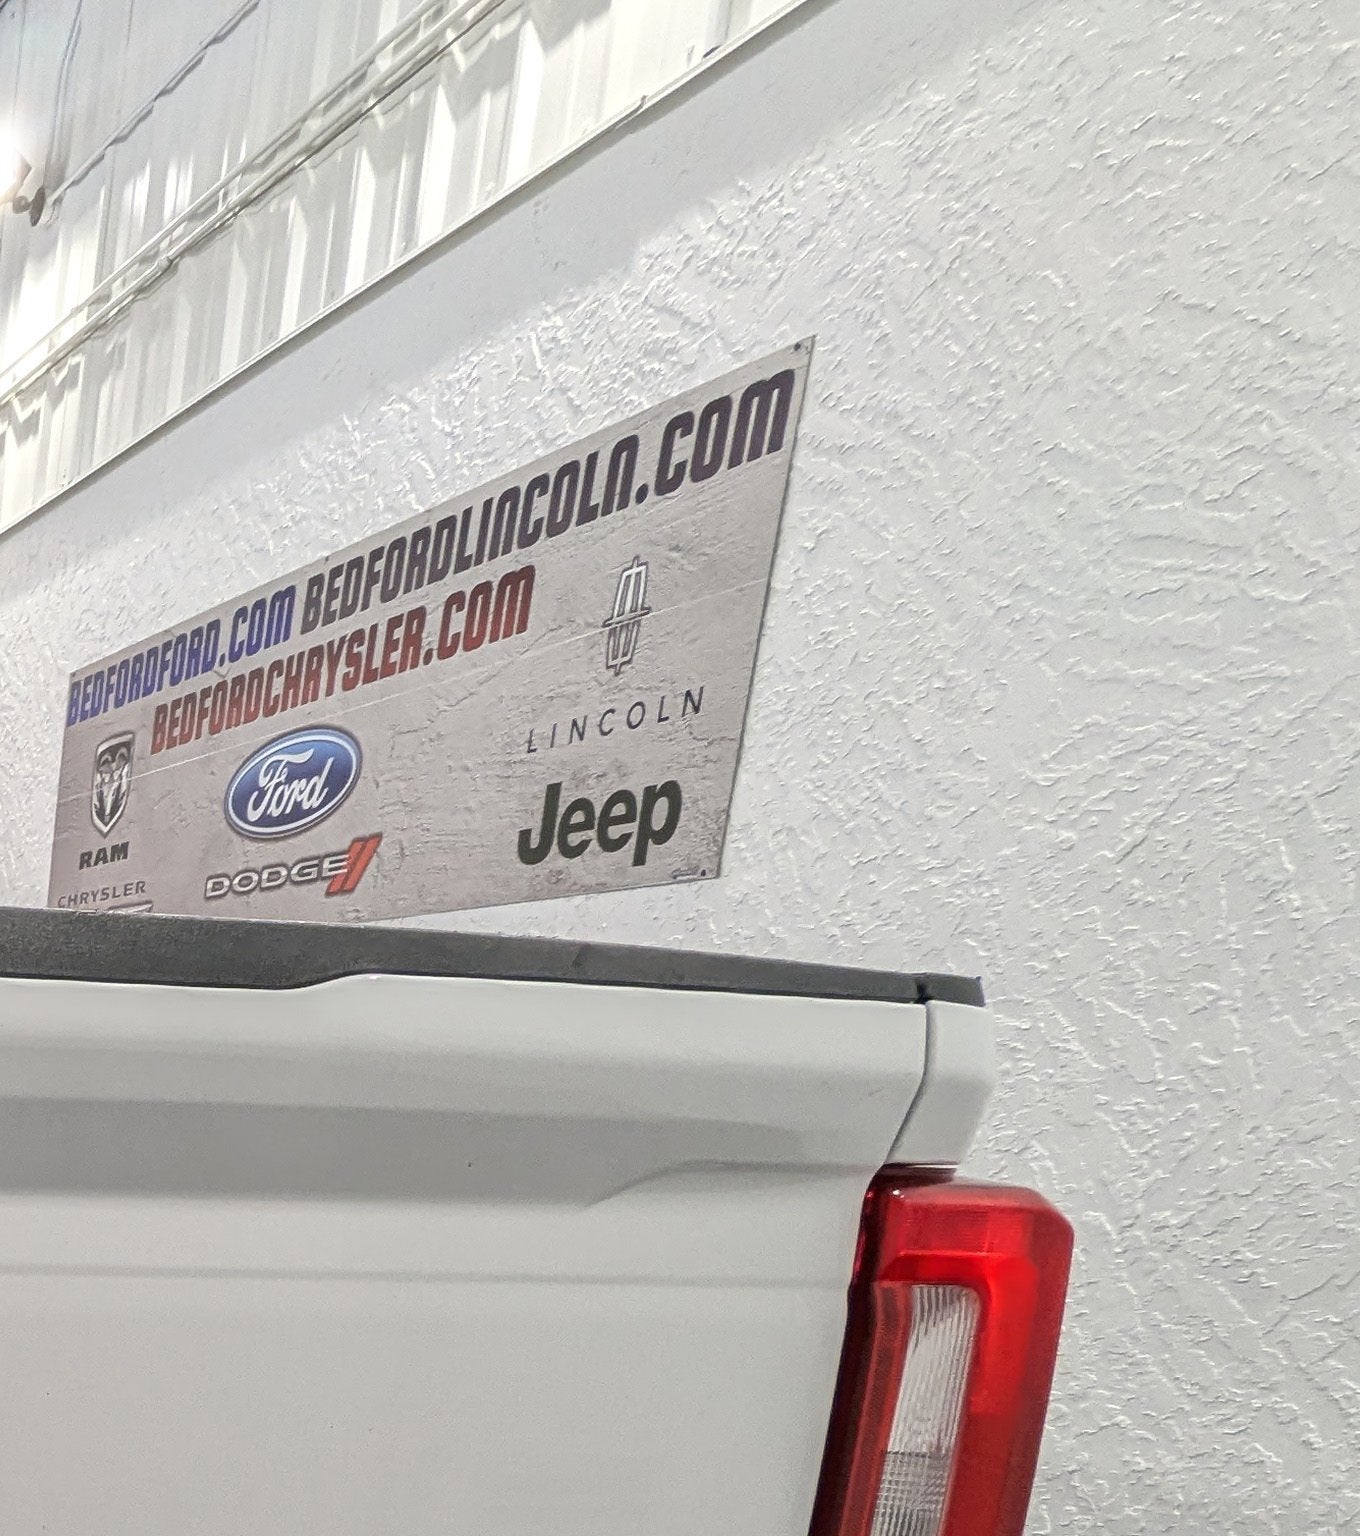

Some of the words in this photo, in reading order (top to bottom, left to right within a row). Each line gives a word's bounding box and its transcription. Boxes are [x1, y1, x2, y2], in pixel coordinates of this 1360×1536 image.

[66, 585, 296, 727] BEDFORDFORD.COM
[300, 369, 795, 635] BEDFORDLINCOLN.COM
[150, 565, 536, 756] BEDFORDCHRYSLER.COM
[527, 686, 704, 754] LINCOLN
[247, 748, 334, 823] Ford
[79, 841, 130, 870] RAM
[517, 779, 683, 867] Jeep
[57, 880, 147, 908] CHRYSLER
[204, 851, 351, 899] DODGE
